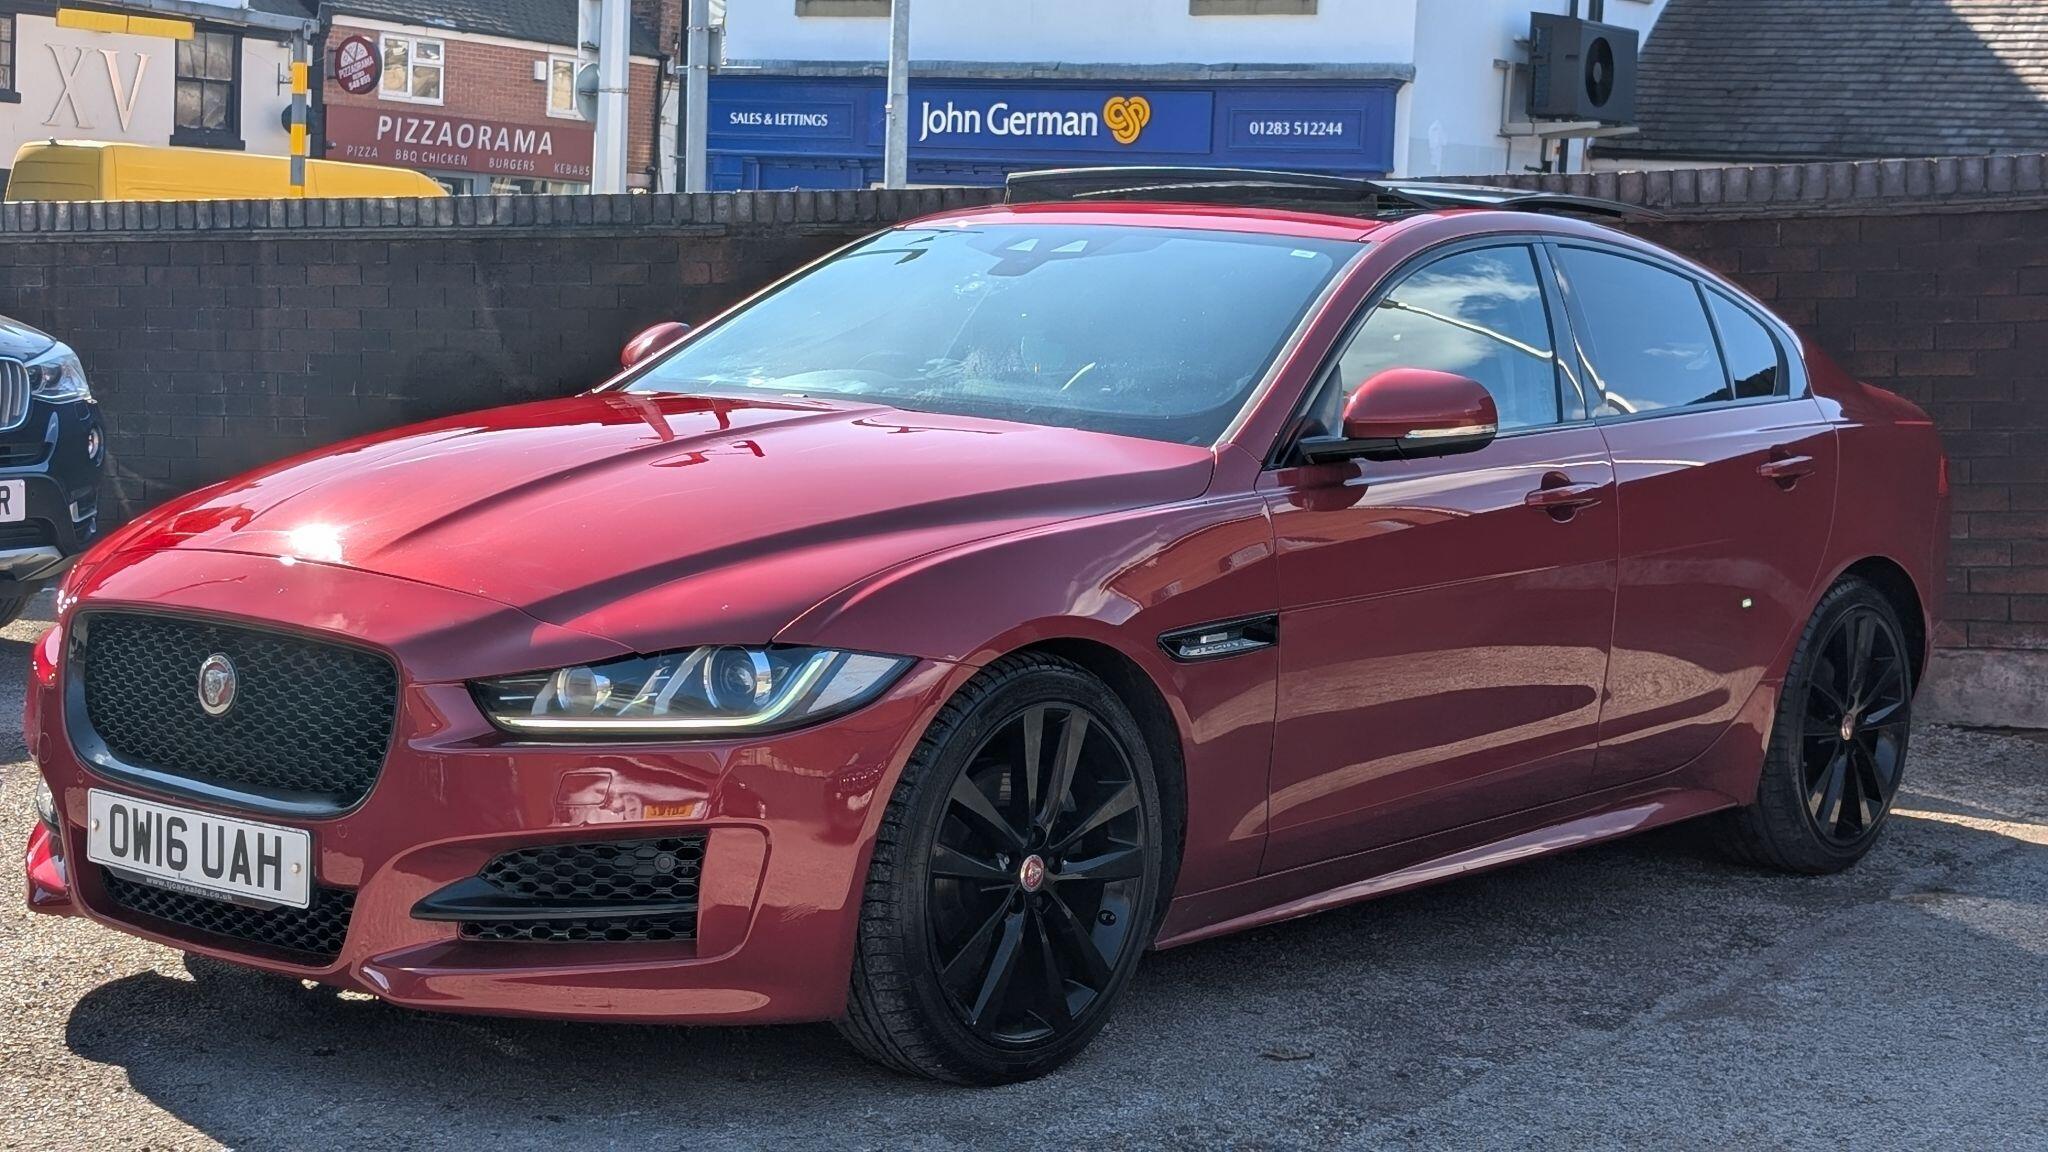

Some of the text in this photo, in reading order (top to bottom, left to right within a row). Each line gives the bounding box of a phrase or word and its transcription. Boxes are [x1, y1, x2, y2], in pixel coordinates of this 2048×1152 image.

[41, 43, 151, 132] XV
[377, 115, 553, 156] PIZZAORAMA
[730, 112, 828, 127] SALES & LETTINGS
[919, 102, 1098, 142] John German
[1249, 121, 1343, 136] 01283 512244
[346, 145, 590, 176] PIZZA BBQ CHICKEN BURGERS KEBABS
[109, 803, 282, 892] OW16 UAH
